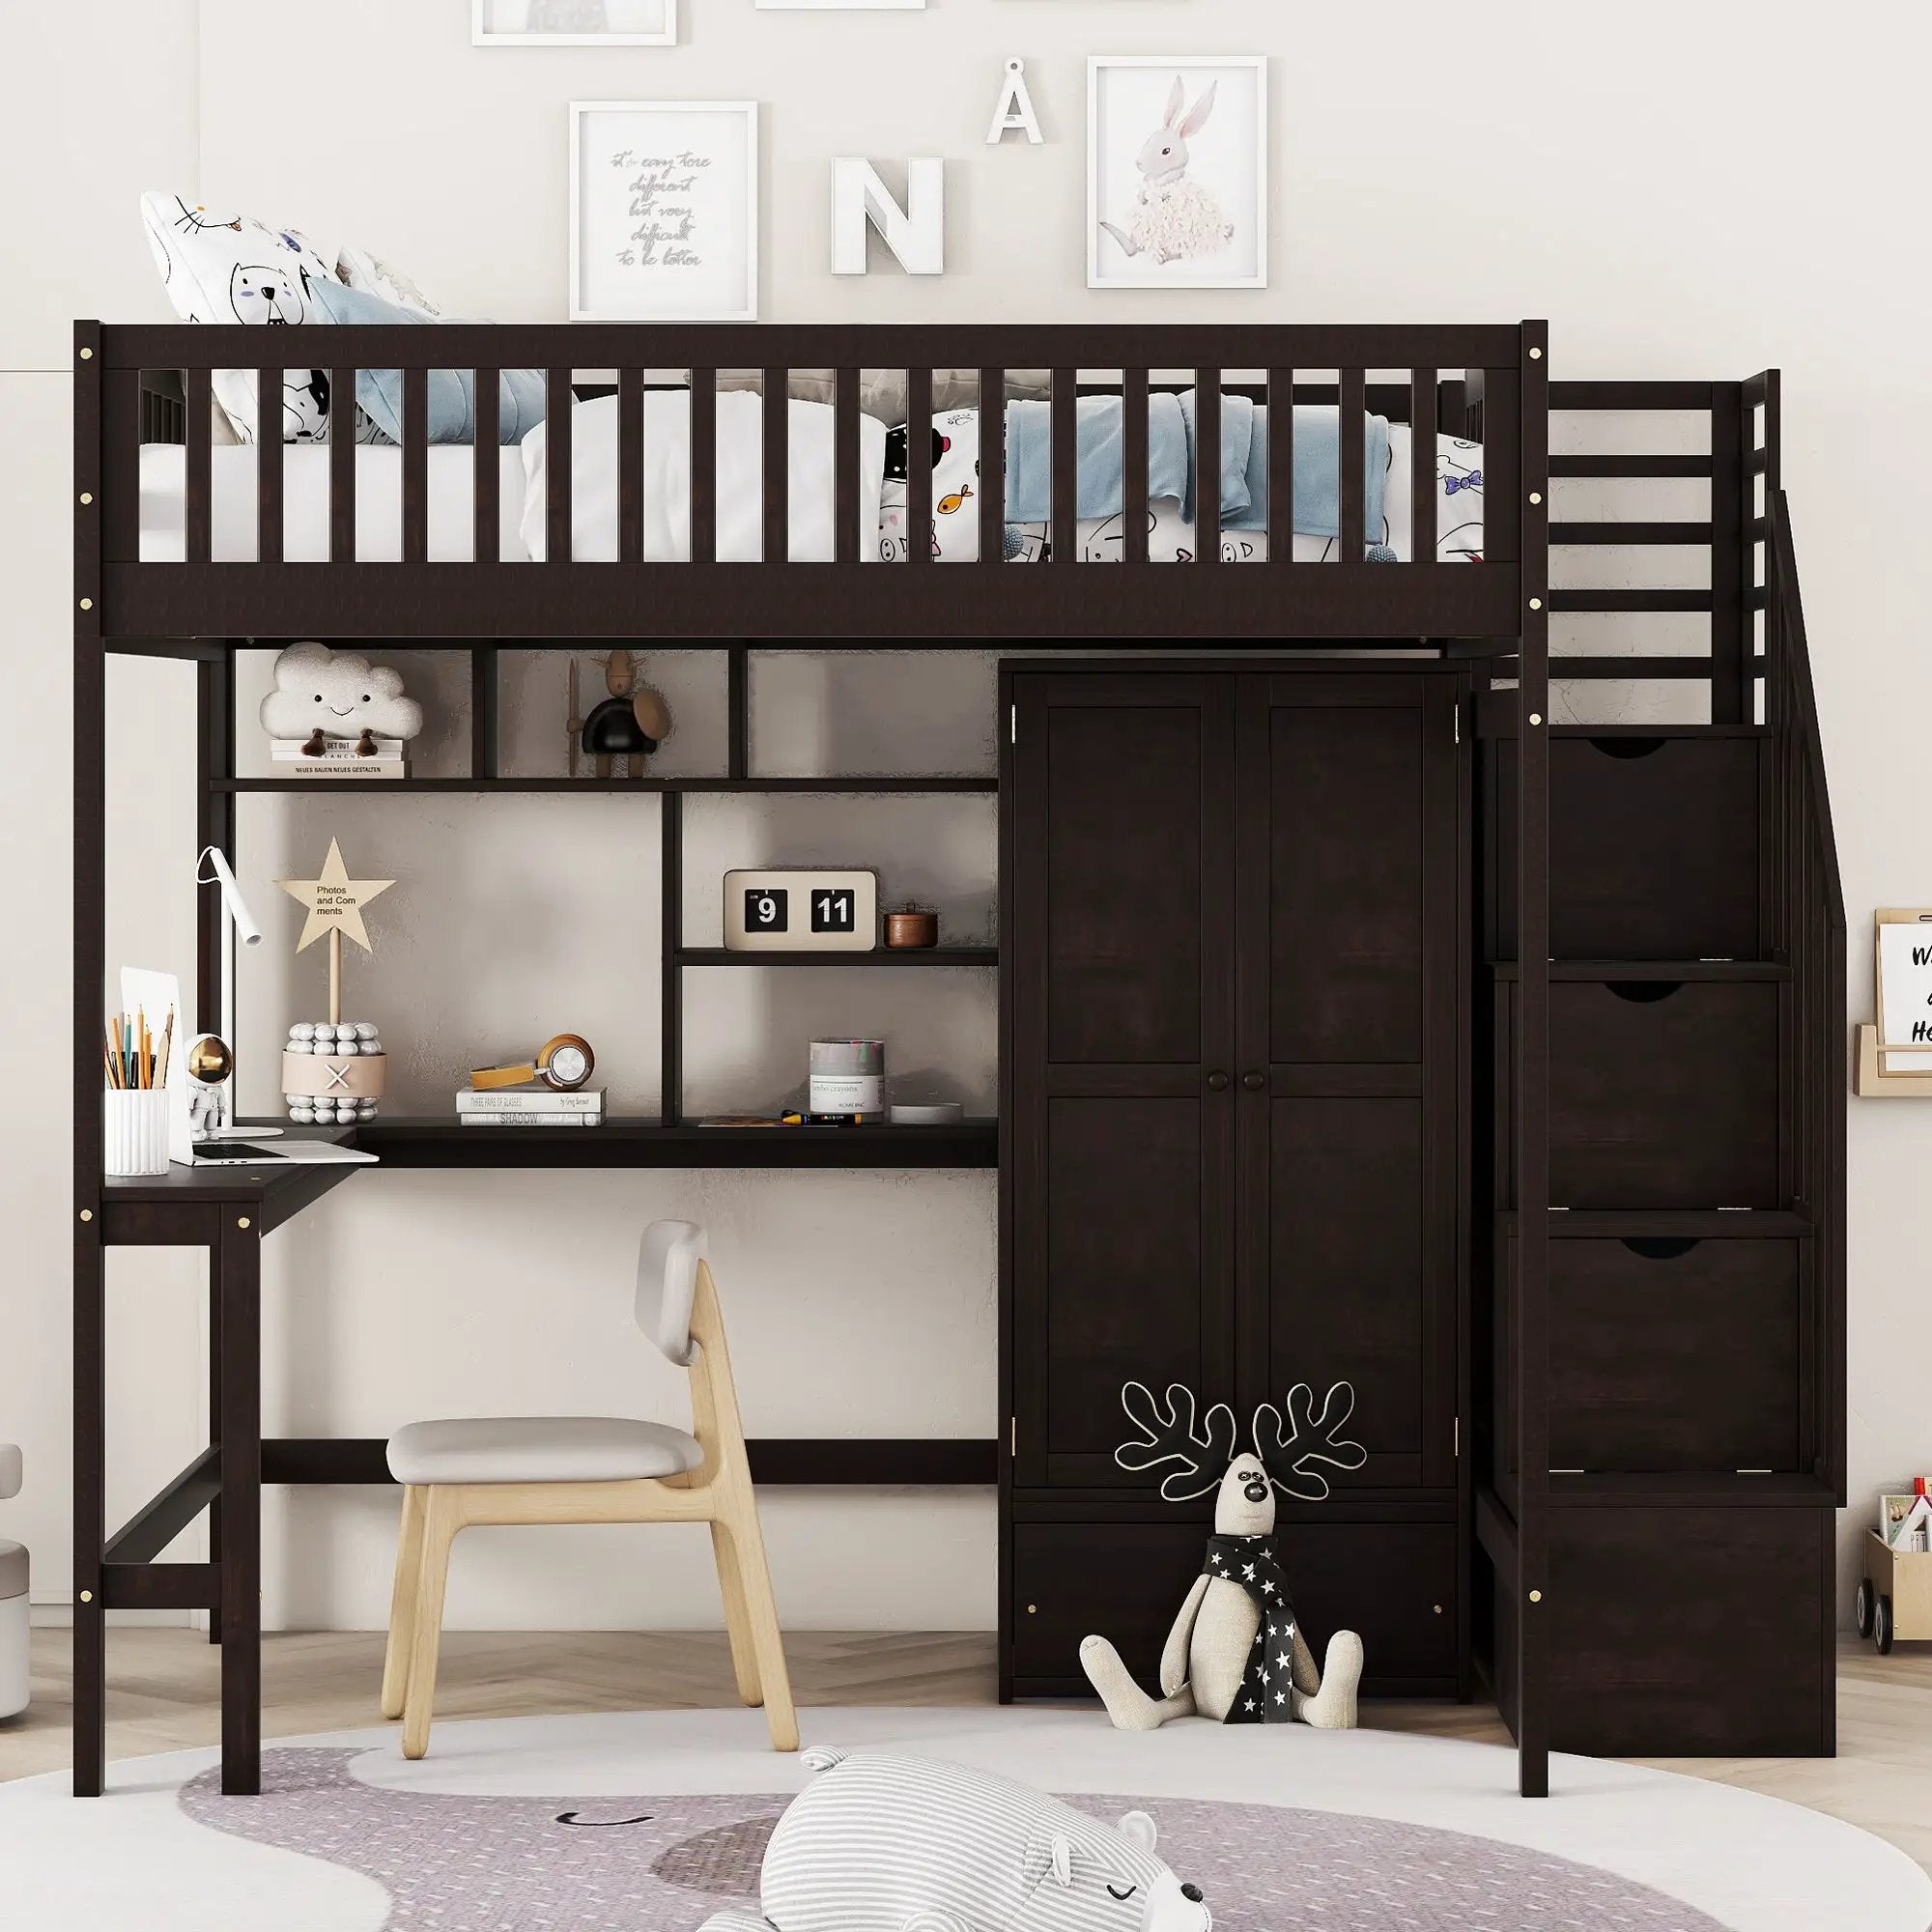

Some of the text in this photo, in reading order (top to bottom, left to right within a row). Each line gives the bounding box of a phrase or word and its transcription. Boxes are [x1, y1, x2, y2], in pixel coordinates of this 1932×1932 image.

[831, 156, 944, 275] N
[615, 249, 635, 266] to
[317, 886, 347, 895] Photos
[758, 897, 847, 923] 9 11
[1912, 947, 1932, 966] W
[500, 1113, 538, 1124] SHADOW
